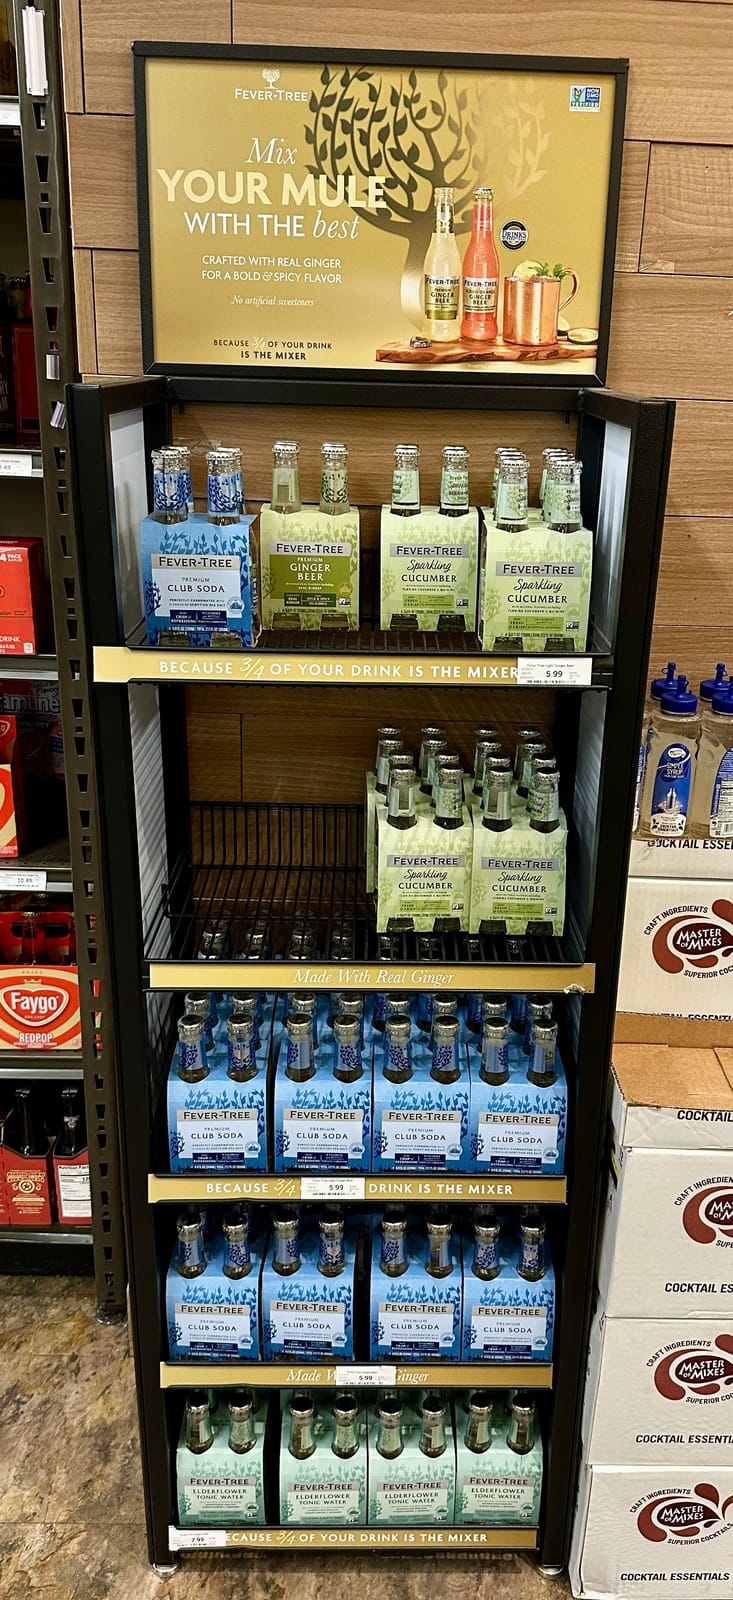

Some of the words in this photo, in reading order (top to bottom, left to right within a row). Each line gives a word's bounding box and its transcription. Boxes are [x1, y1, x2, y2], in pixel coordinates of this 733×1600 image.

[234, 88, 308, 102] FEVER-TREE
[245, 137, 298, 165] Mix
[156, 168, 272, 205] YOUR
[281, 172, 387, 208] MULE
[184, 212, 250, 236] WITH
[258, 214, 305, 237] THE
[312, 210, 360, 240] best
[202, 255, 246, 266] CRAFTED
[249, 256, 275, 266] WITH
[278, 257, 301, 268] REAL
[304, 258, 342, 268] GINGER
[202, 270, 222, 280] FOR
[224, 272, 231, 280] A
[234, 272, 260, 281] BOLD
[262, 272, 274, 282] &
[274, 272, 302, 282] SPICY
[304, 274, 342, 283] FLAVOR
[231, 295, 244, 305] No
[244, 296, 276, 307] artificial
[278, 298, 314, 306] sweeteners
[275, 352, 306, 360] MIXER
[276, 543, 344, 554] FEVER-TREE
[396, 546, 462, 556] FEVER-TREE
[159, 556, 232, 568] FEVER-TREE
[290, 563, 330, 572] GINGER
[407, 560, 452, 572] Sparkling
[503, 564, 574, 574] FEVER-TREE
[297, 573, 323, 581] BEER
[401, 574, 457, 583] CUCUMBER
[168, 584, 193, 592] CLUB
[197, 585, 225, 593] SODA
[514, 579, 563, 593] Sparkling
[508, 594, 568, 604] CUCUMBER
[160, 661, 233, 674] BECAUSE
[270, 664, 290, 675] OF
[299, 664, 347, 676] YOUR
[352, 664, 401, 677] DRINK
[409, 666, 424, 677] IS
[431, 666, 461, 678] THE
[468, 666, 517, 678] MIXER
[393, 856, 458, 866] FEVER-TREE
[488, 859, 553, 869] FEVER-TREE
[404, 868, 448, 881] Sparkling
[498, 871, 542, 884] Sparkling
[644, 915, 662, 936] CRAFT
[661, 905, 709, 919] INGREDIENTS
[676, 928, 722, 945] MASTER
[687, 938, 722, 950] MIXES
[293, 969, 332, 983] Made
[338, 969, 371, 983] With
[376, 969, 406, 984] Real
[411, 970, 454, 988] Ginger
[684, 969, 718, 979] SUPERIOR
[11, 992, 57, 1014] Faygo
[184, 1111, 250, 1120] FEVER-TREE
[290, 1111, 356, 1120] FEVER-TREE
[389, 1112, 454, 1120] FEVER-TREE
[486, 1114, 551, 1124] FEVER-TREE
[677, 1110, 733, 1122] COCKTAIL
[206, 1184, 269, 1192] BECAUSE
[369, 1184, 412, 1193] DRINK
[419, 1184, 431, 1193] IS
[437, 1184, 463, 1194] THE
[468, 1185, 513, 1195] MIXER
[674, 1186, 694, 1206] CRAFT
[665, 1283, 717, 1293] COCKTAIL
[181, 1305, 243, 1314] FEVER-TREE
[276, 1303, 338, 1312] FEVER-TREE
[385, 1304, 447, 1313] FEVER-TREE
[478, 1307, 540, 1316] FEVER-TREE
[646, 1349, 665, 1367] CRAFT
[664, 1340, 711, 1352] INGREDIENTS
[678, 1360, 724, 1375] MASTER
[286, 1369, 321, 1382] Made
[690, 1368, 724, 1379] MIXES
[635, 1435, 685, 1443] COCKTAIL
[470, 1477, 528, 1485] FEVER-TREE
[630, 1497, 646, 1513] CRAFT
[646, 1488, 691, 1499] INGREDIENTS
[661, 1505, 703, 1519] MASTER
[670, 1512, 704, 1523] MIXES
[320, 1534, 355, 1542] YOUR
